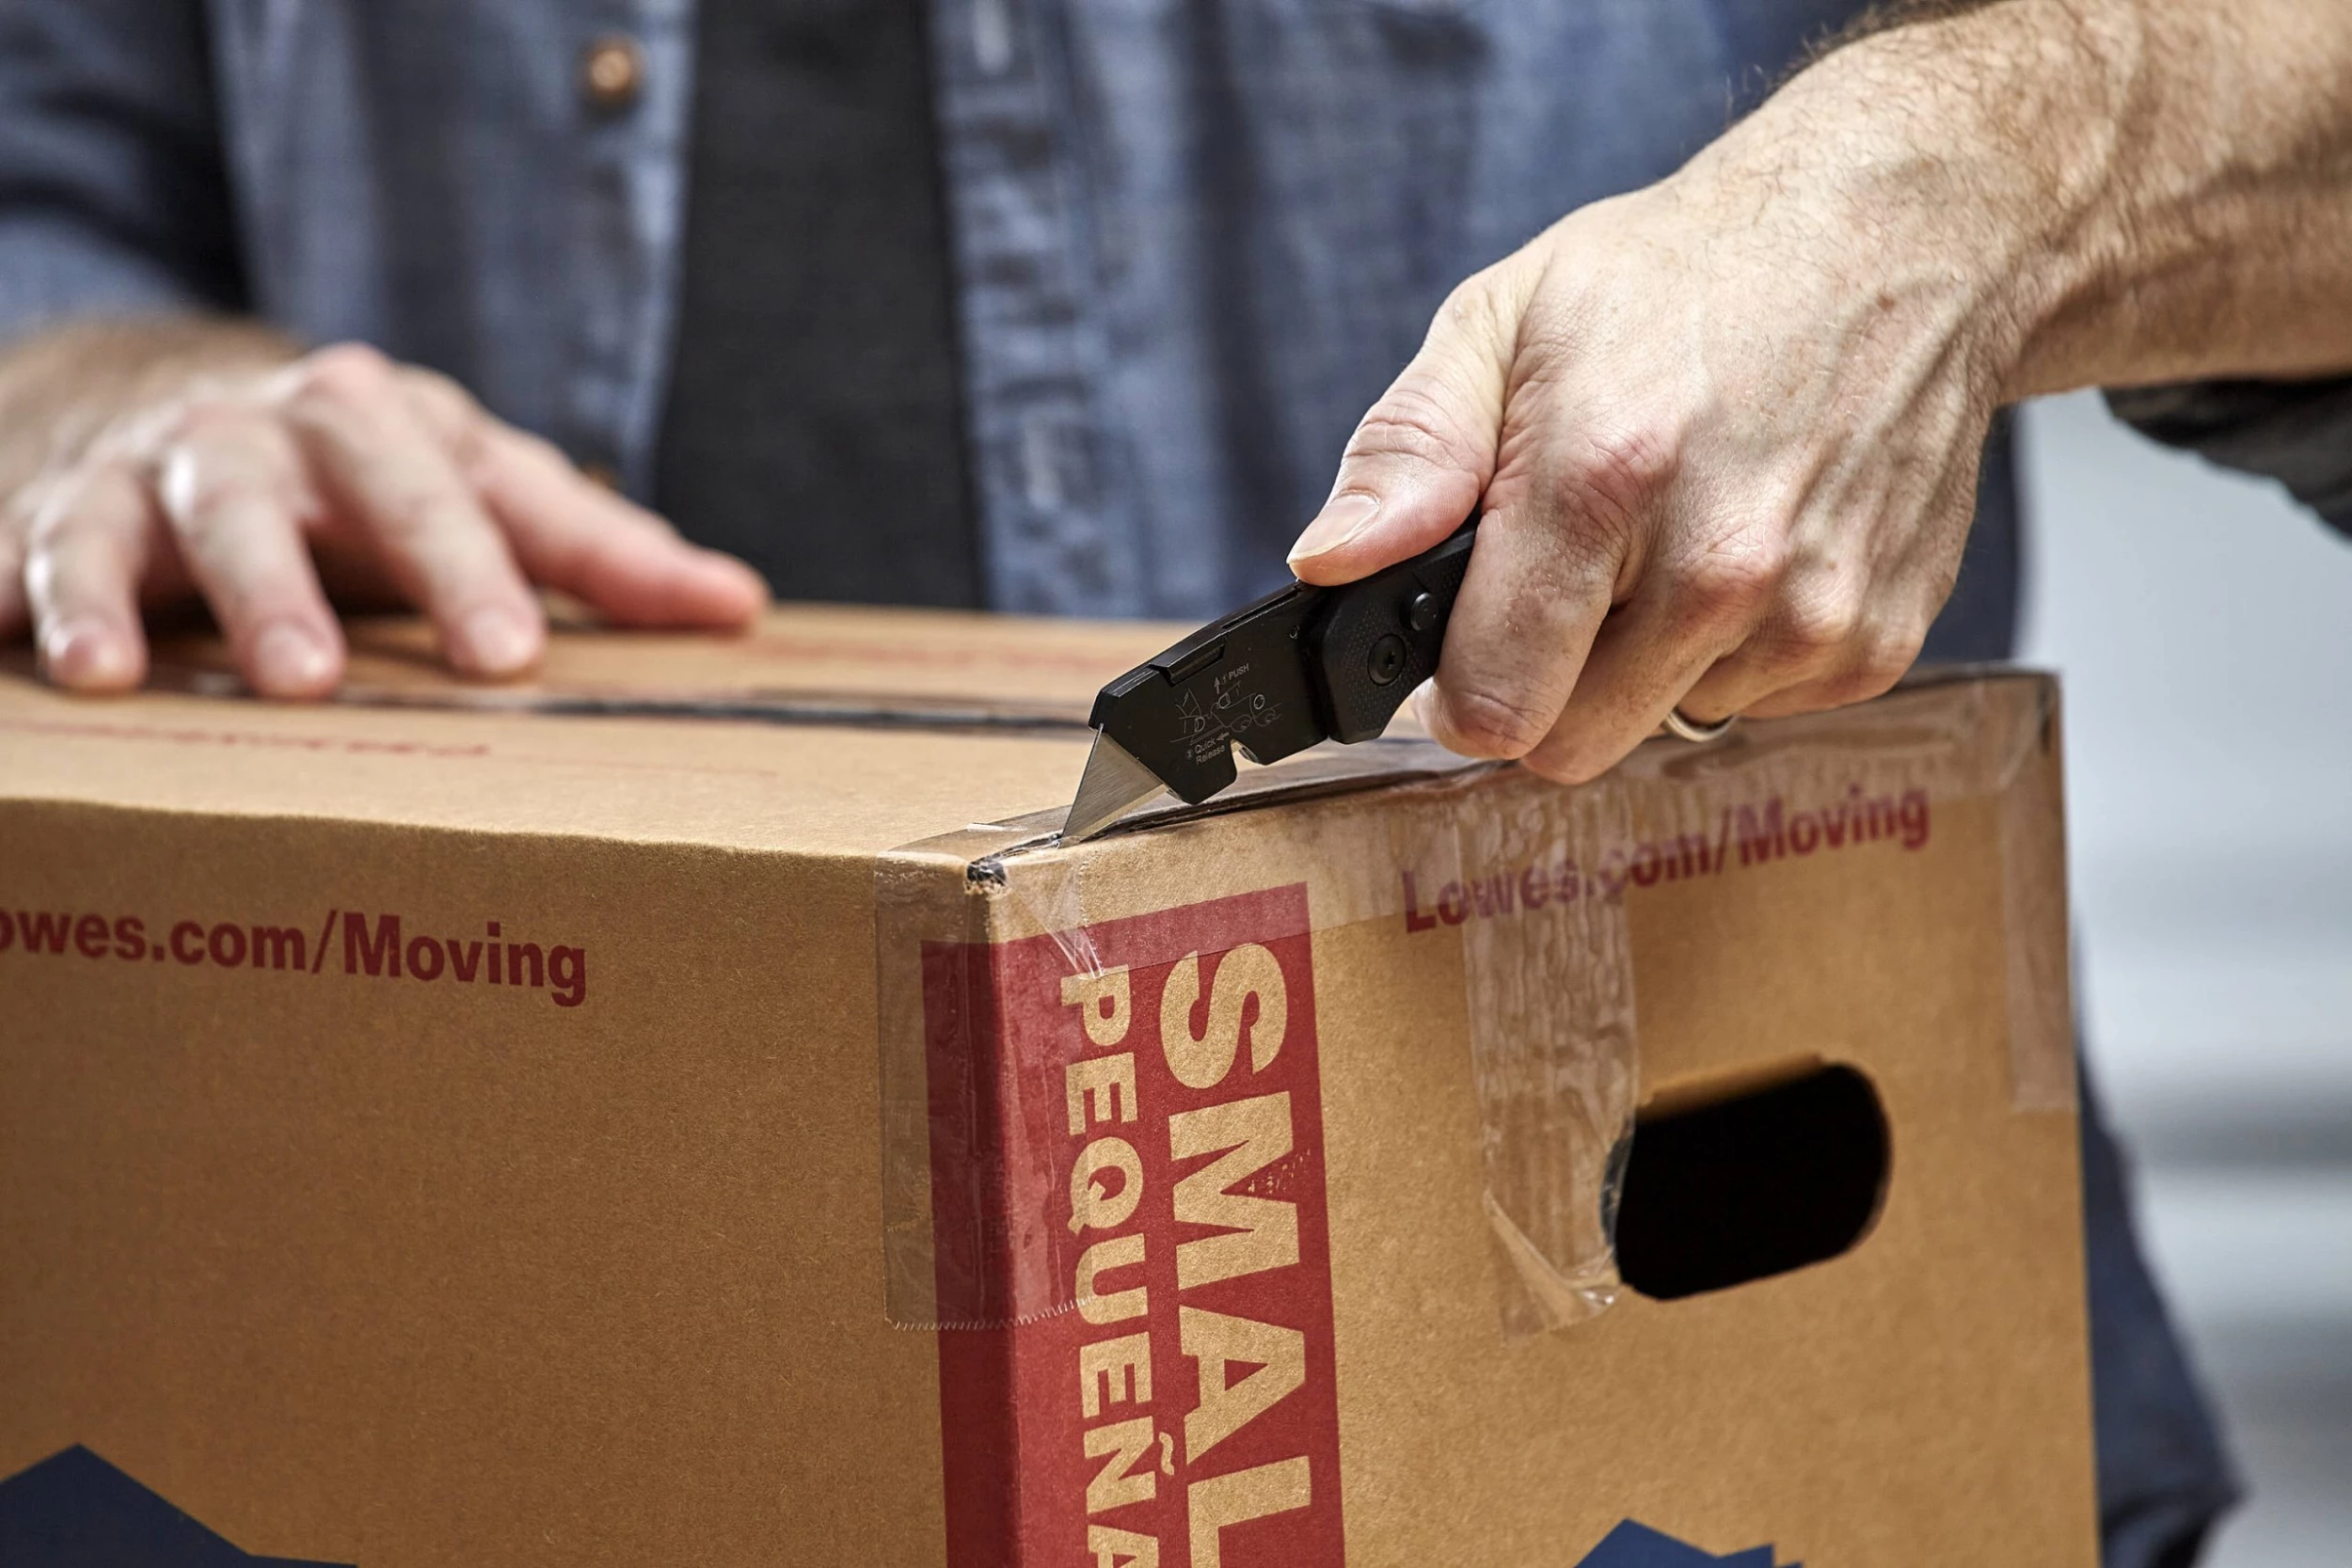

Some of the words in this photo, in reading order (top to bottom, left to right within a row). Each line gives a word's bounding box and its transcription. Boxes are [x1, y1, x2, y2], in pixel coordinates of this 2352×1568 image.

[1228, 662, 1249, 680] PUSH
[1194, 737, 1216, 754] Quick
[1196, 744, 1226, 766] Release
[1402, 783, 1930, 934] Lowes.com/Moving
